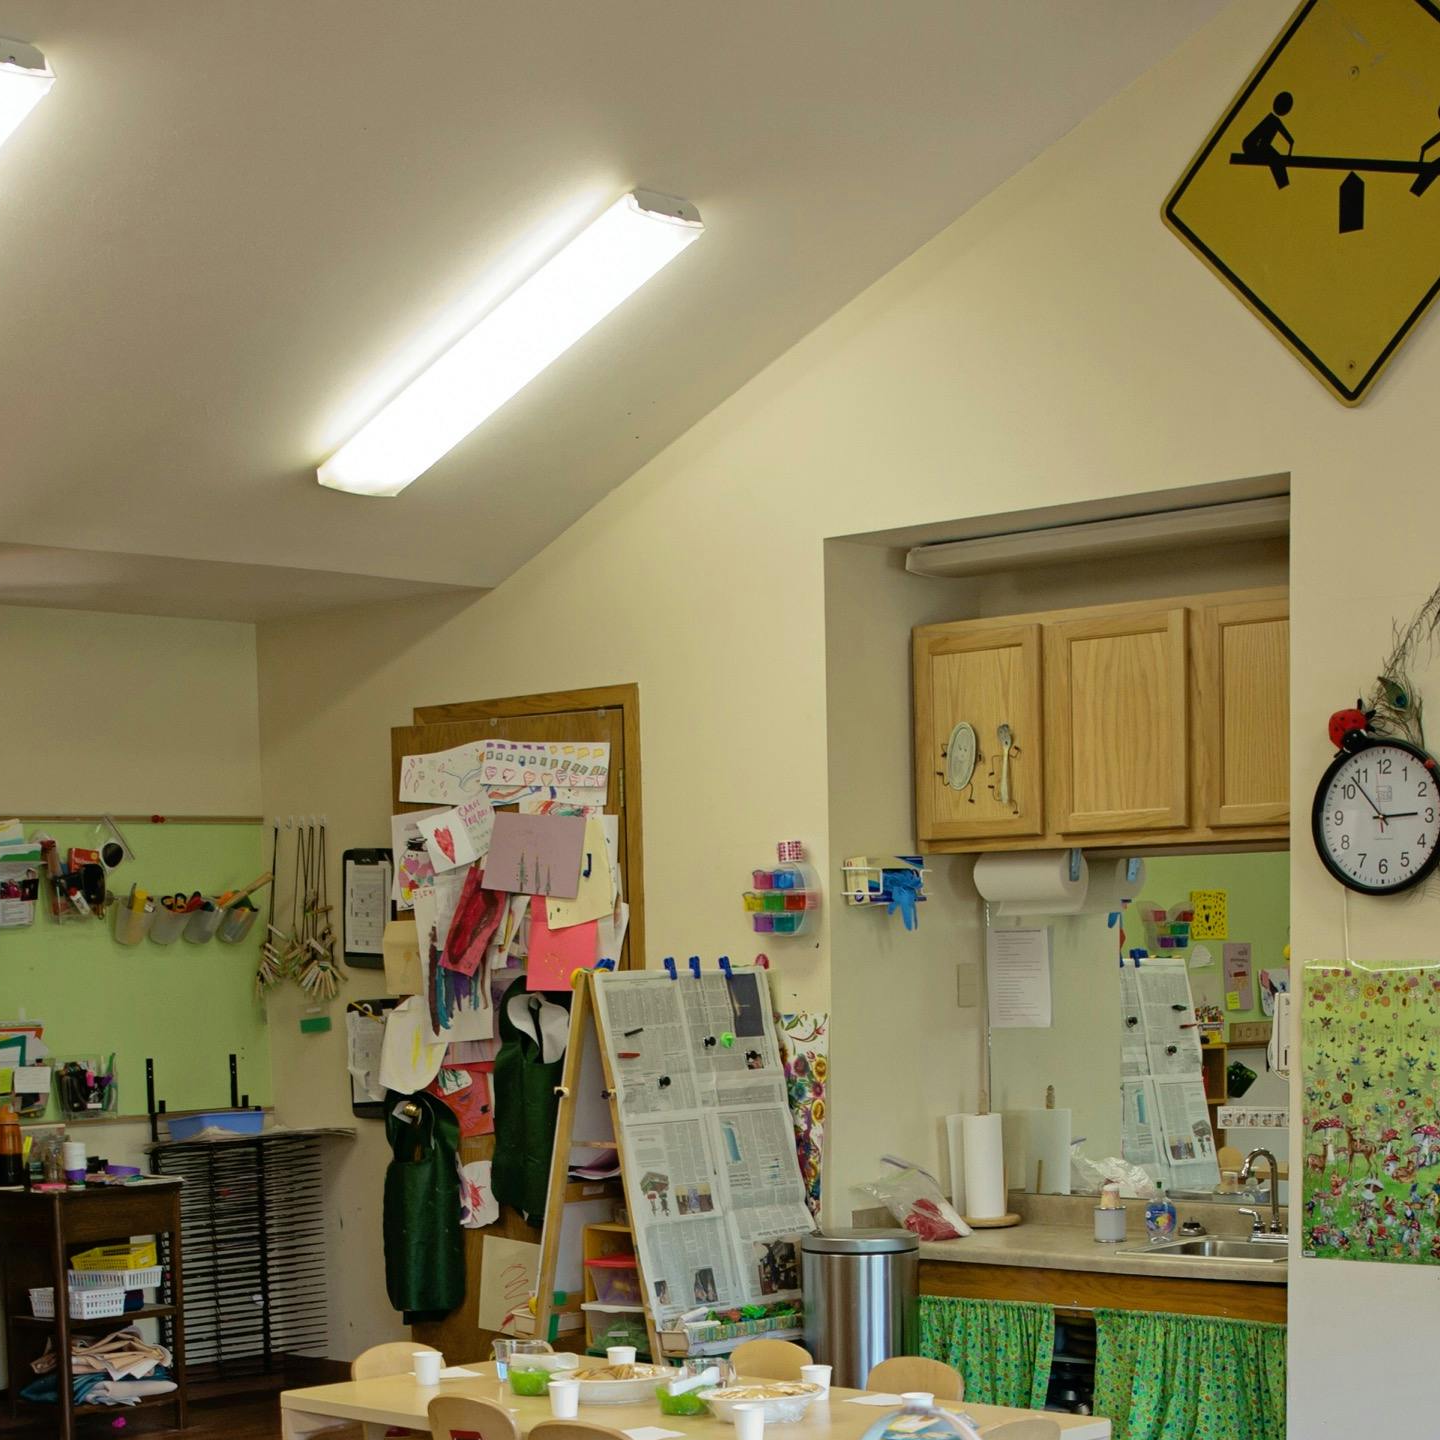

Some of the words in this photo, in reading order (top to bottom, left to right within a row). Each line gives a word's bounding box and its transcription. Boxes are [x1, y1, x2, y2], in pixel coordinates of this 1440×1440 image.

[1377, 759, 1392, 774] 12
[1356, 768, 1368, 783] 11
[1402, 767, 1408, 782] 1
[1341, 784, 1356, 800] 10
[1418, 782, 1427, 797] 2
[1334, 811, 1344, 826] 9
[1424, 808, 1434, 823] 3
[1341, 834, 1350, 850] 8
[1417, 833, 1426, 848] 4
[1358, 853, 1367, 868] 7
[1378, 859, 1388, 874] 6
[1400, 852, 1410, 867] 5
